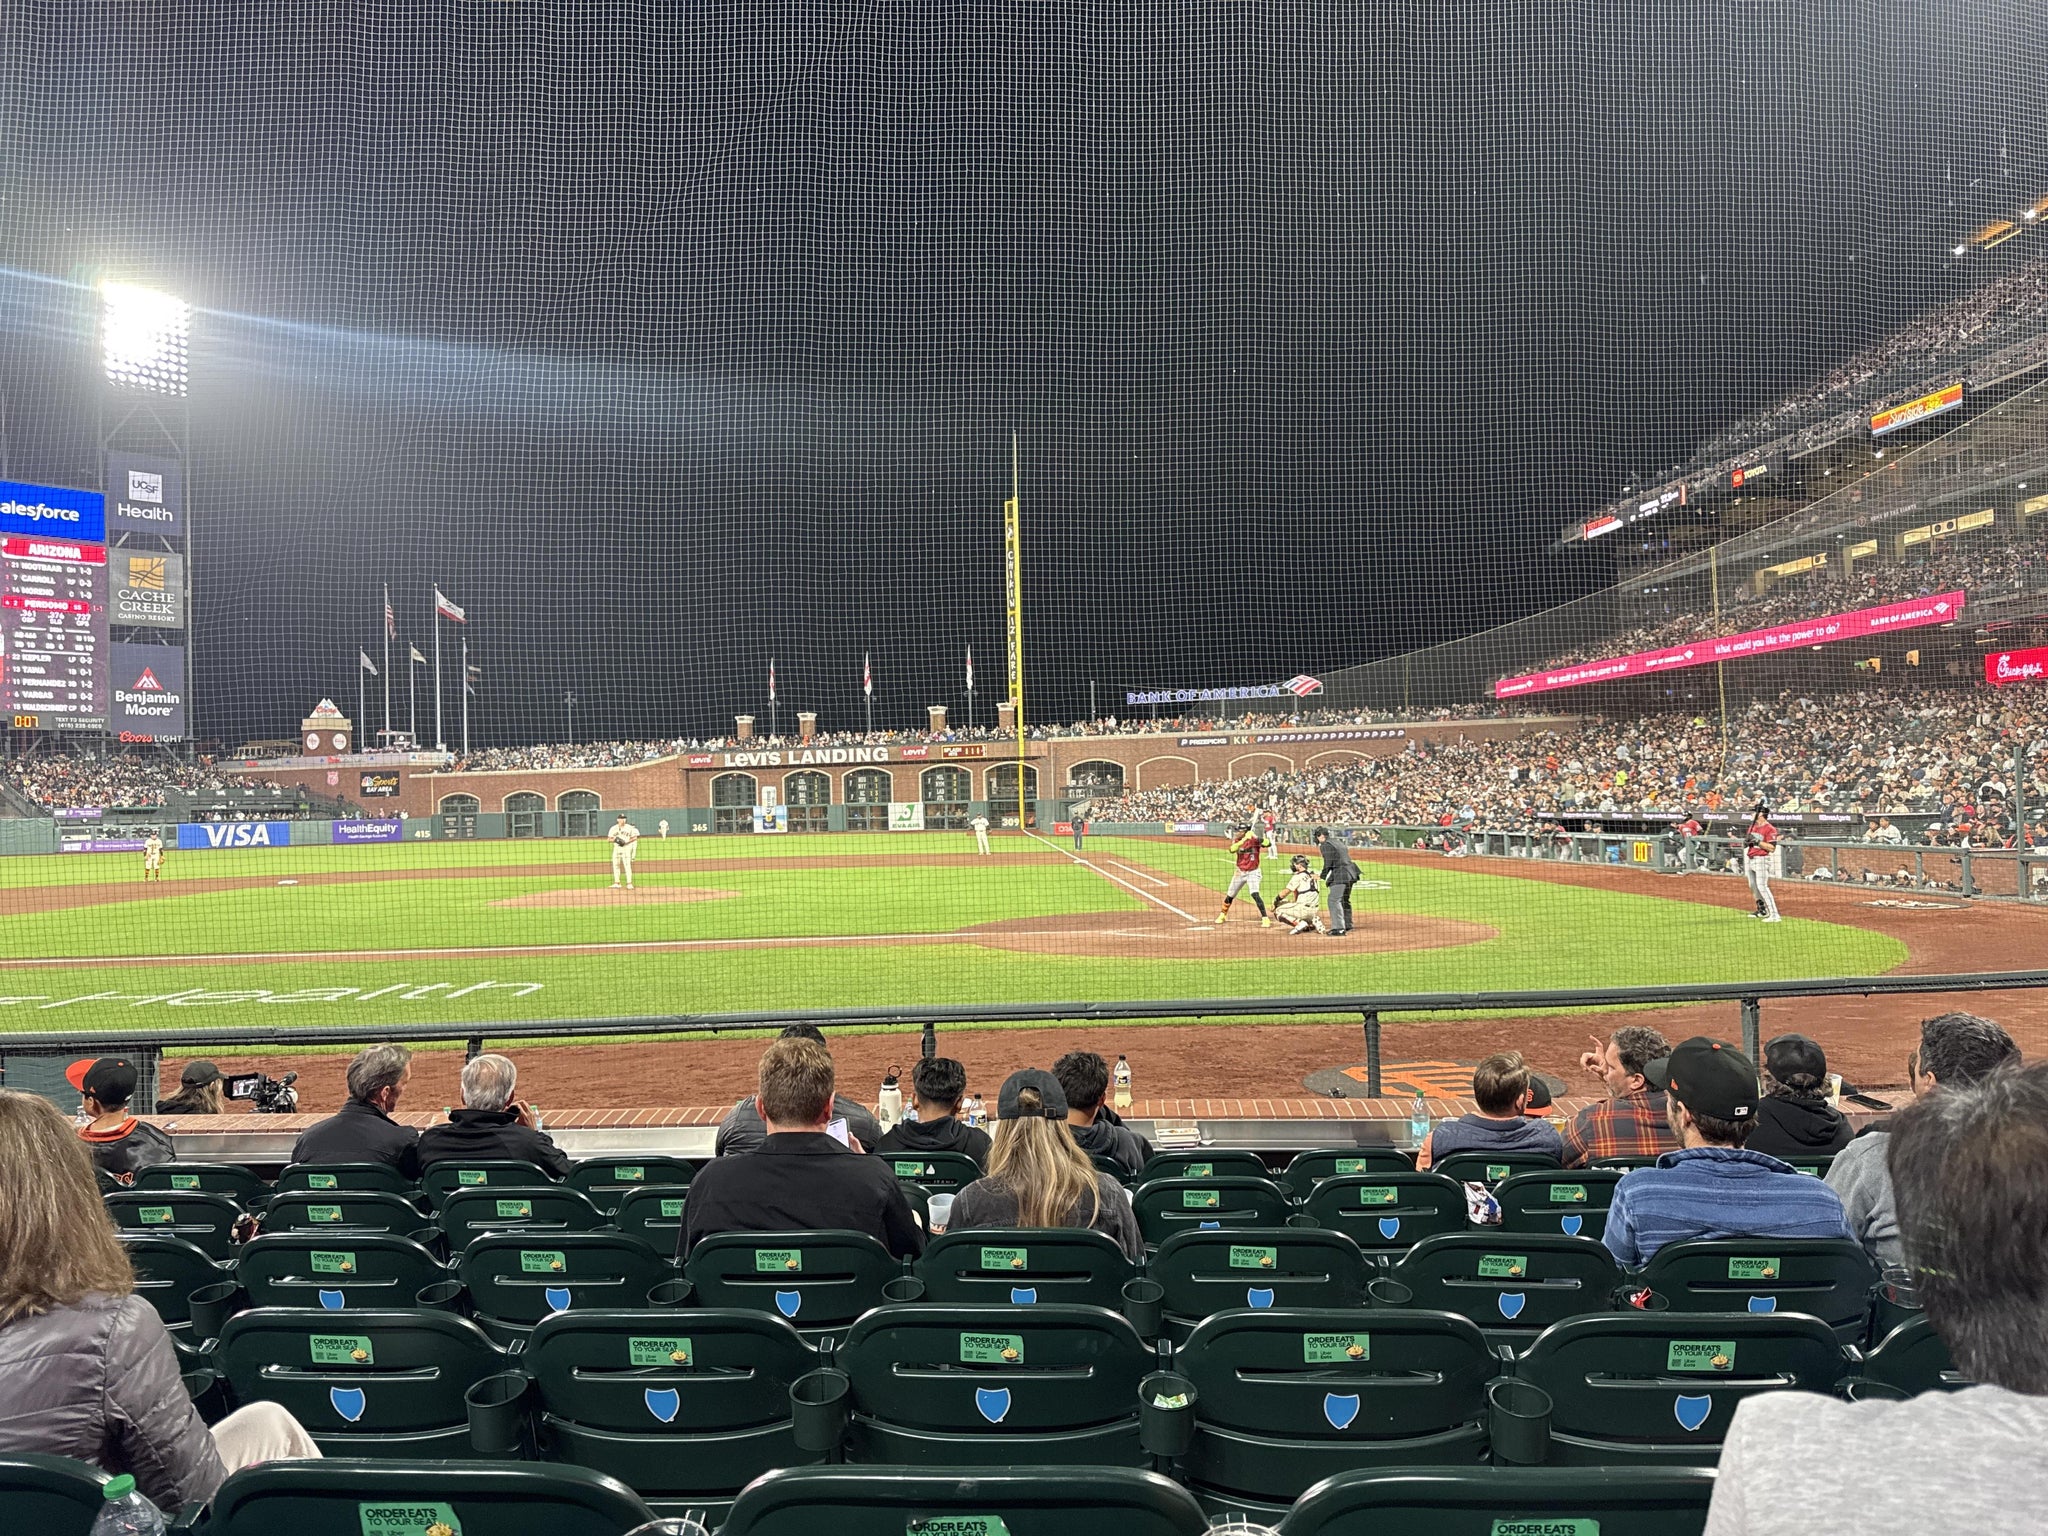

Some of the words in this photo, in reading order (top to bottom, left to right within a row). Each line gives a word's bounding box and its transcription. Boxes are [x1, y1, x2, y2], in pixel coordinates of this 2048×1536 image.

[1889, 404, 1924, 426] Surfside
[1744, 465, 1767, 479] TOYOTA
[132, 480, 159, 494] UCSF
[0, 500, 80, 521] alesforce
[117, 502, 173, 522] Health
[29, 543, 81, 559] ARIZONA
[21, 574, 56, 584] CARROLL
[118, 589, 175, 603] CACHE
[24, 600, 68, 610] PERDOMO
[120, 601, 174, 615] CREEK
[118, 613, 145, 621] CASINO
[148, 614, 176, 622] RESORT
[1870, 616, 1889, 626] BANK
[1890, 615, 1899, 623] OF
[1900, 609, 1933, 621] AMERICA
[1714, 642, 1731, 654] What
[1732, 639, 1752, 652] would
[1752, 639, 1764, 651] you
[1765, 634, 1777, 645] like
[1779, 632, 1791, 643] the
[1792, 629, 1814, 643] power
[1816, 625, 1825, 636] to
[1826, 622, 1840, 635] do?
[80, 657, 93, 665] 0-2
[81, 681, 93, 689] 1-2
[22, 691, 54, 699] VARGAS
[80, 693, 93, 701] 0-2
[115, 690, 180, 705] Benjamin
[1127, 691, 1171, 705] BANK
[1176, 689, 1197, 702] OF
[1200, 685, 1280, 701] AMERICA
[80, 705, 93, 713] 0-2
[125, 704, 173, 716] Moore
[119, 730, 153, 743] Coors
[154, 735, 183, 743] LIGHT
[788, 747, 888, 764] LANDING
[373, 775, 398, 787] Sports
[692, 823, 708, 832] 365
[1002, 818, 1019, 826] 309
[338, 823, 398, 834] HealthEquity
[414, 830, 431, 838] 415
[201, 823, 270, 847] VISA
[40, 981, 544, 1009] Health
[365, 1508, 407, 1518] ORDER
[408, 1508, 437, 1517] EATS
[368, 1518, 382, 1526] TO
[413, 1517, 437, 1525] SEAT
[913, 1522, 956, 1531] ORDER
[957, 1522, 987, 1531] EATS
[1497, 1525, 1542, 1534] ORDER
[1544, 1524, 1576, 1534] EATS
